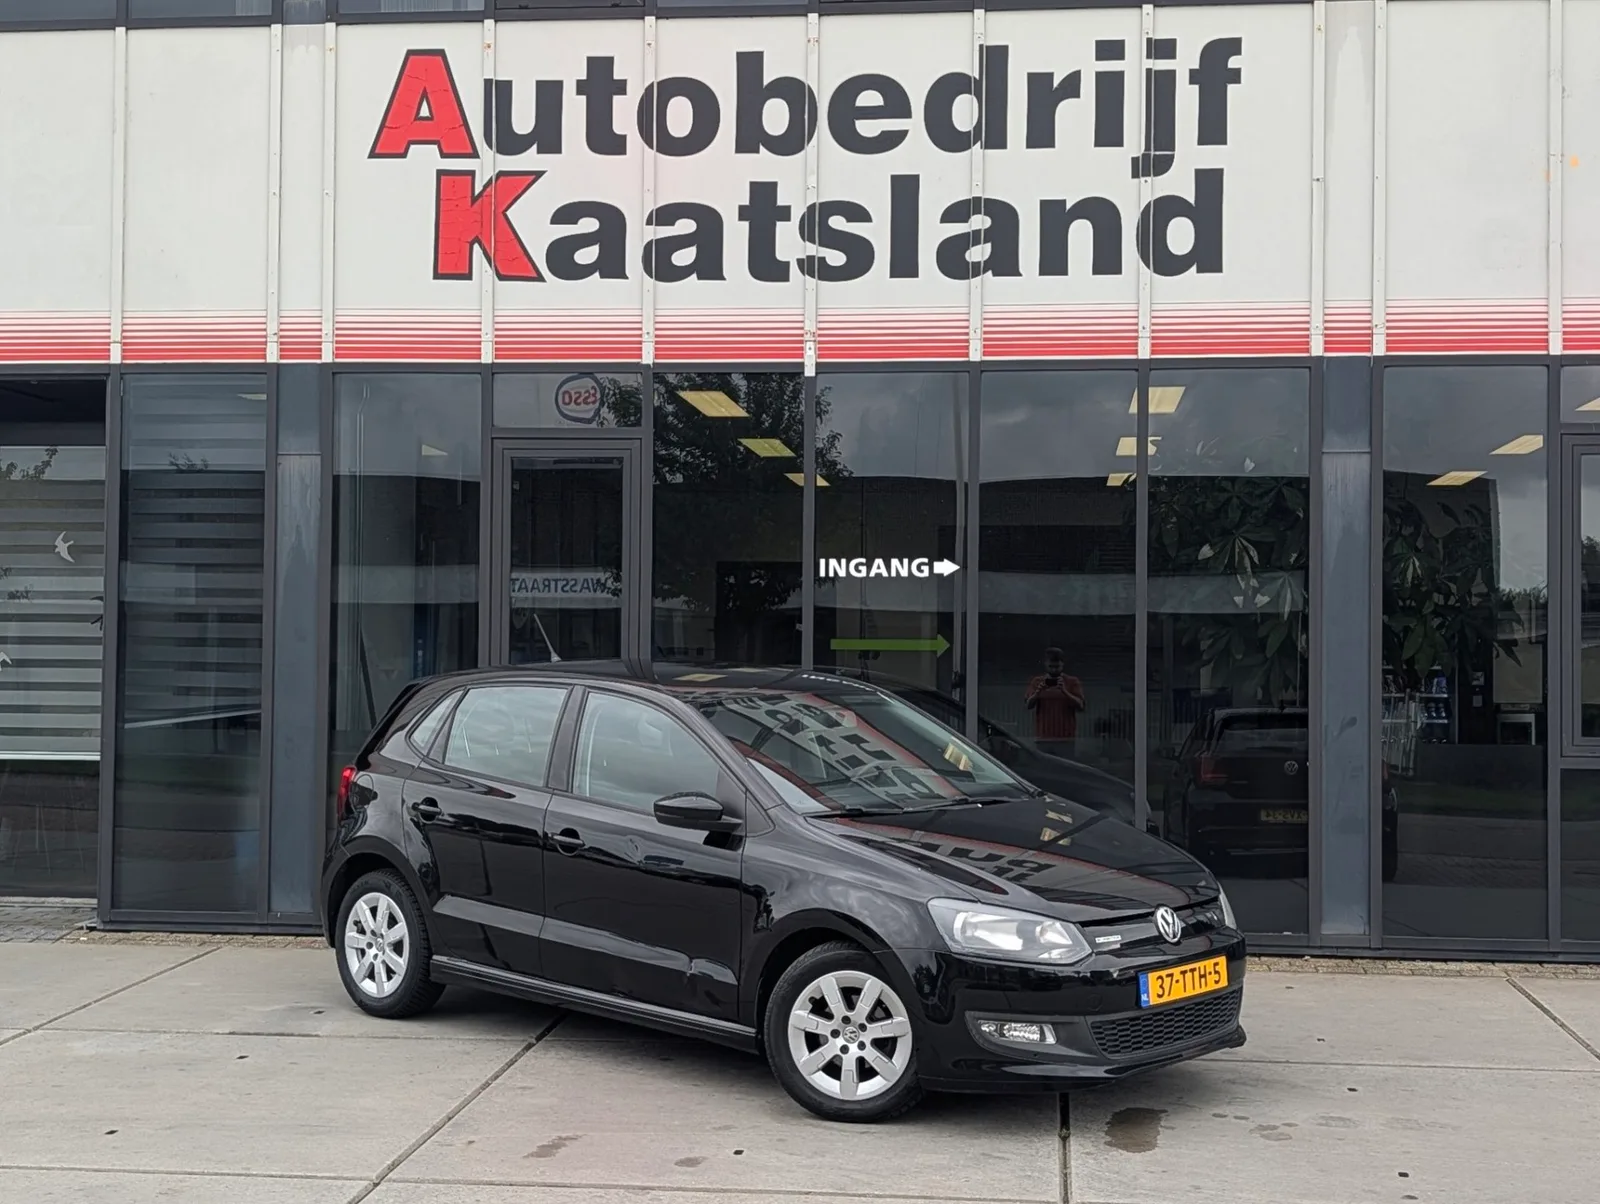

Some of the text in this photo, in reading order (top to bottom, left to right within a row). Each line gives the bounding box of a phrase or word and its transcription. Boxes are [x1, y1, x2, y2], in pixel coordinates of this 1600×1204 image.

[368, 38, 1243, 178] Autobedrijf
[433, 169, 1224, 283] Kaatsland
[819, 557, 930, 578] INGANG
[1156, 962, 1221, 999] 37-TTH-5
